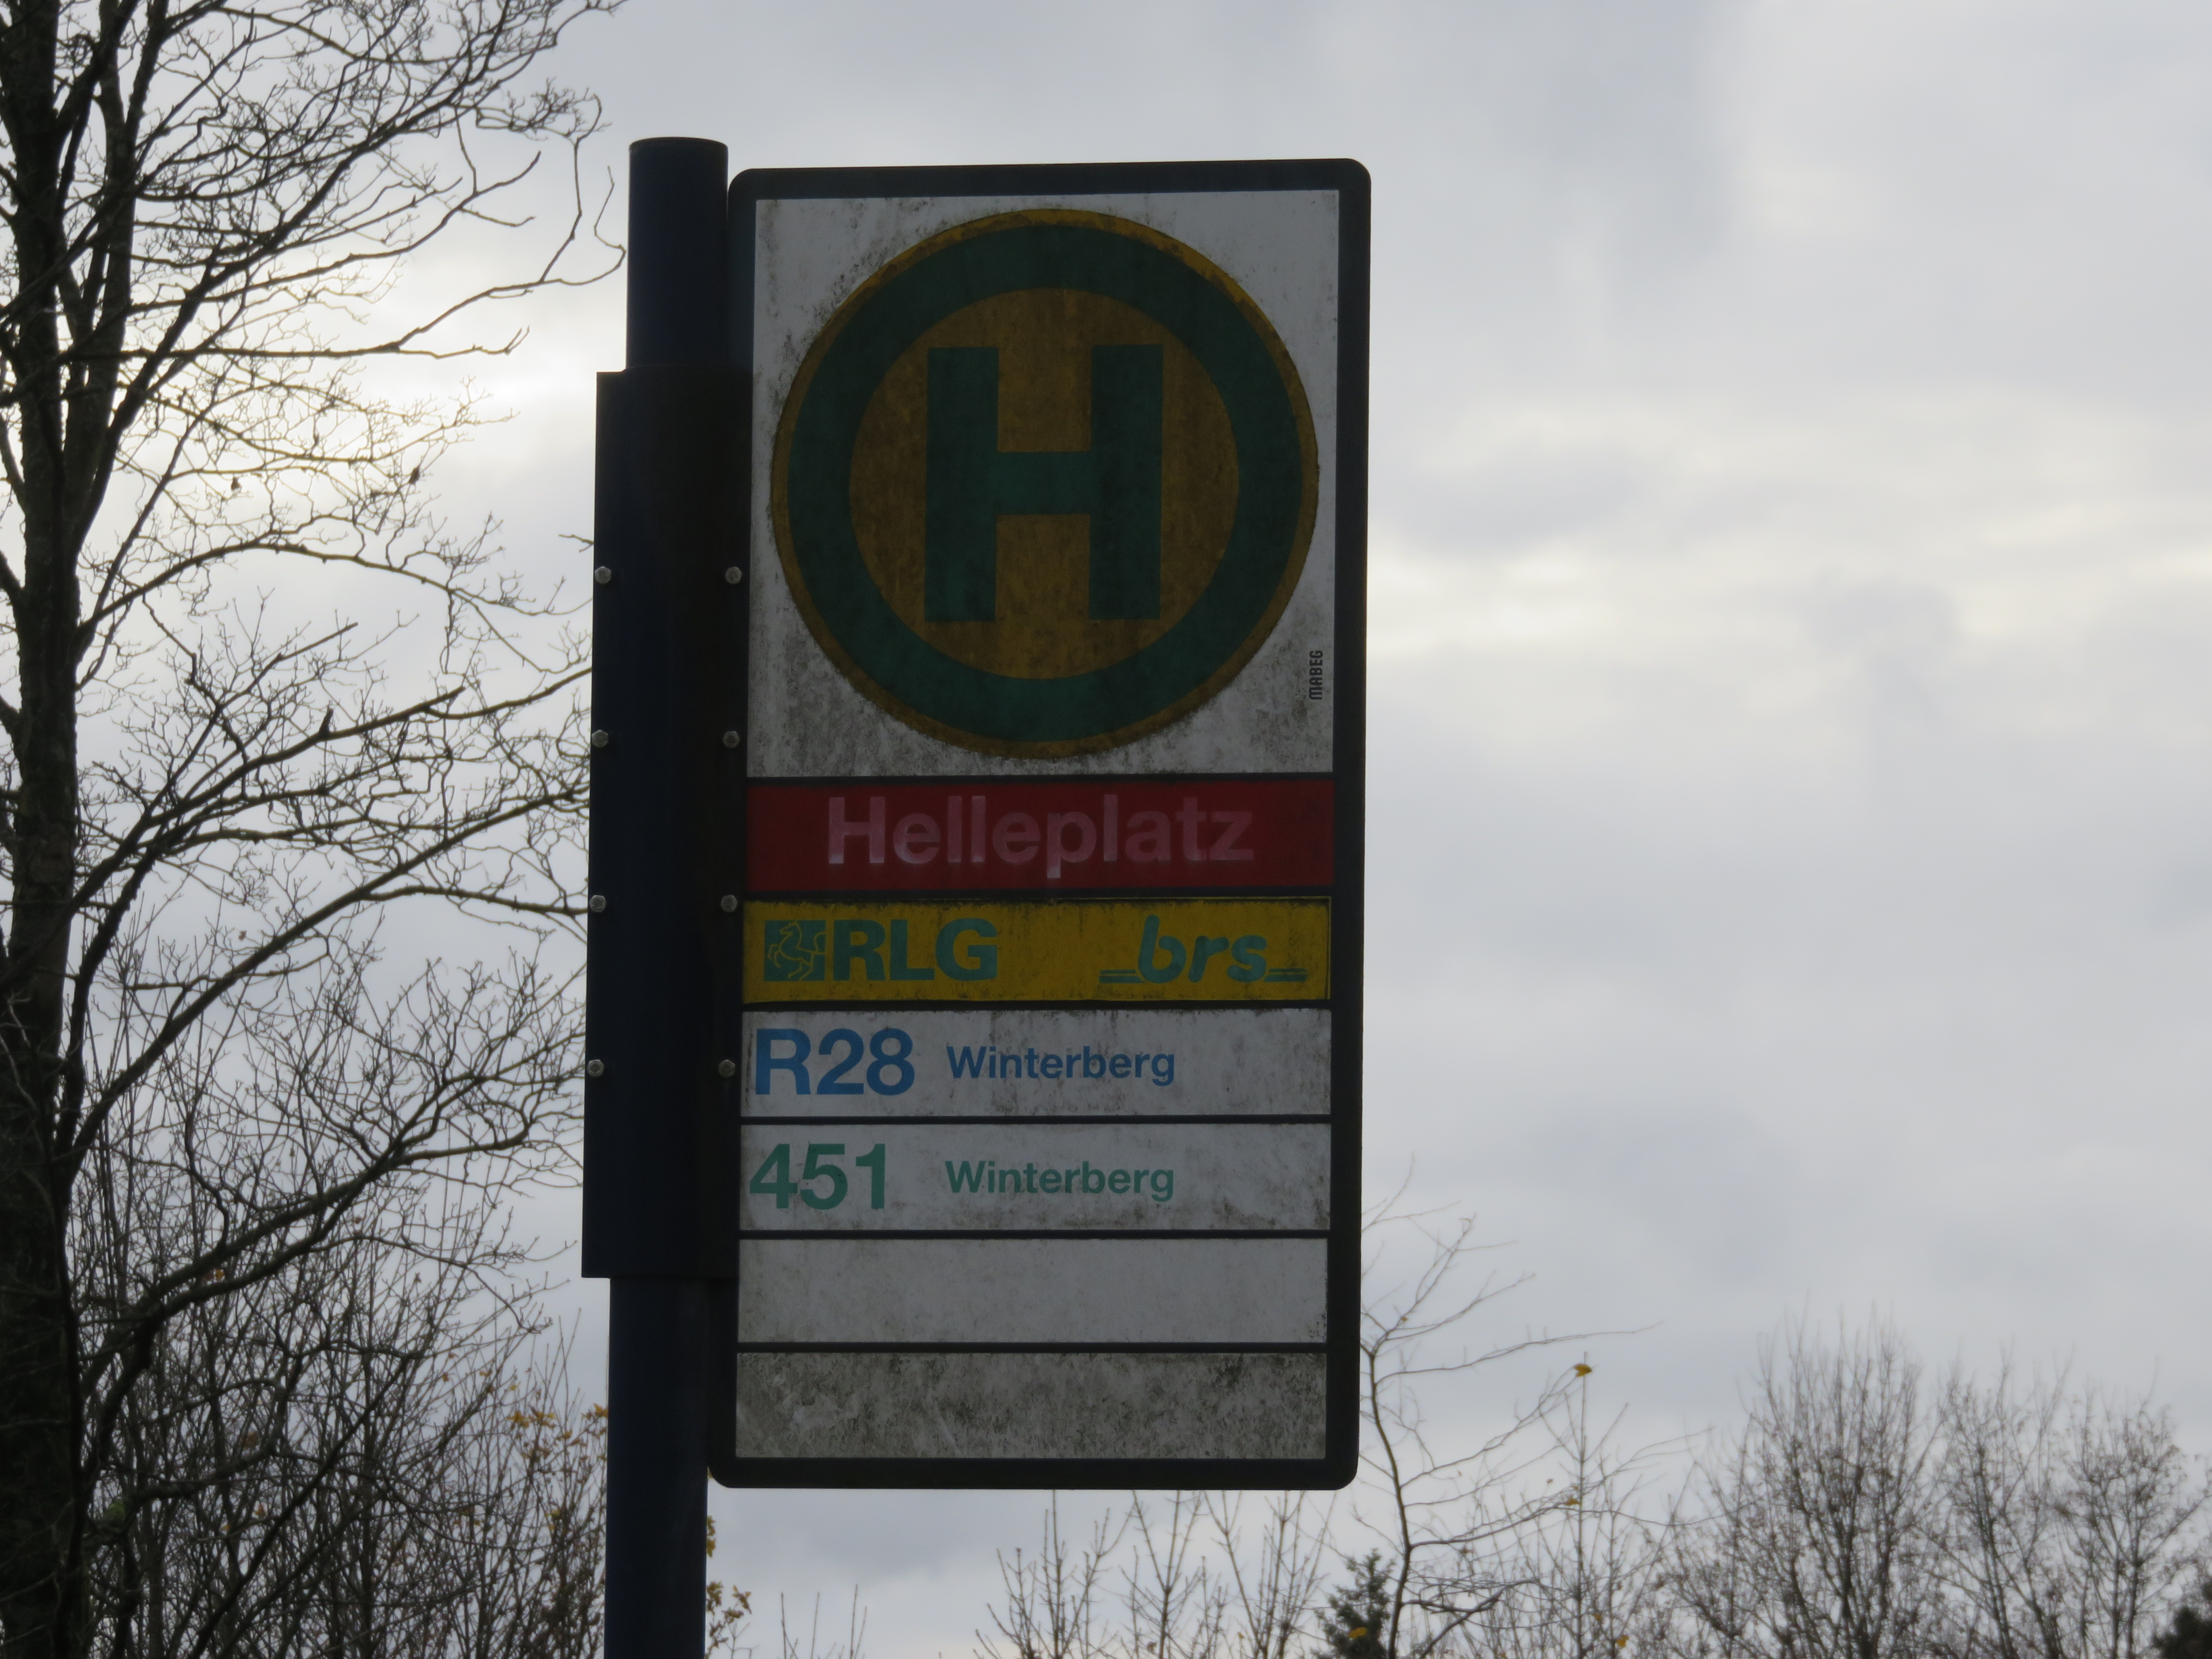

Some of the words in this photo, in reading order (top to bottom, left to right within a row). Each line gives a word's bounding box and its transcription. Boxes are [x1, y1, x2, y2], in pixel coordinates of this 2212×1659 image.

[1309, 650, 1323, 700] MABEG
[829, 794, 1254, 879] Helleplatz
[832, 918, 998, 981] RLG
[1138, 914, 1268, 984] brs
[755, 1028, 915, 1096] R28
[946, 1045, 1175, 1086] Winterberg
[748, 1143, 887, 1210] 451
[945, 1161, 1175, 1202] Winterberg
